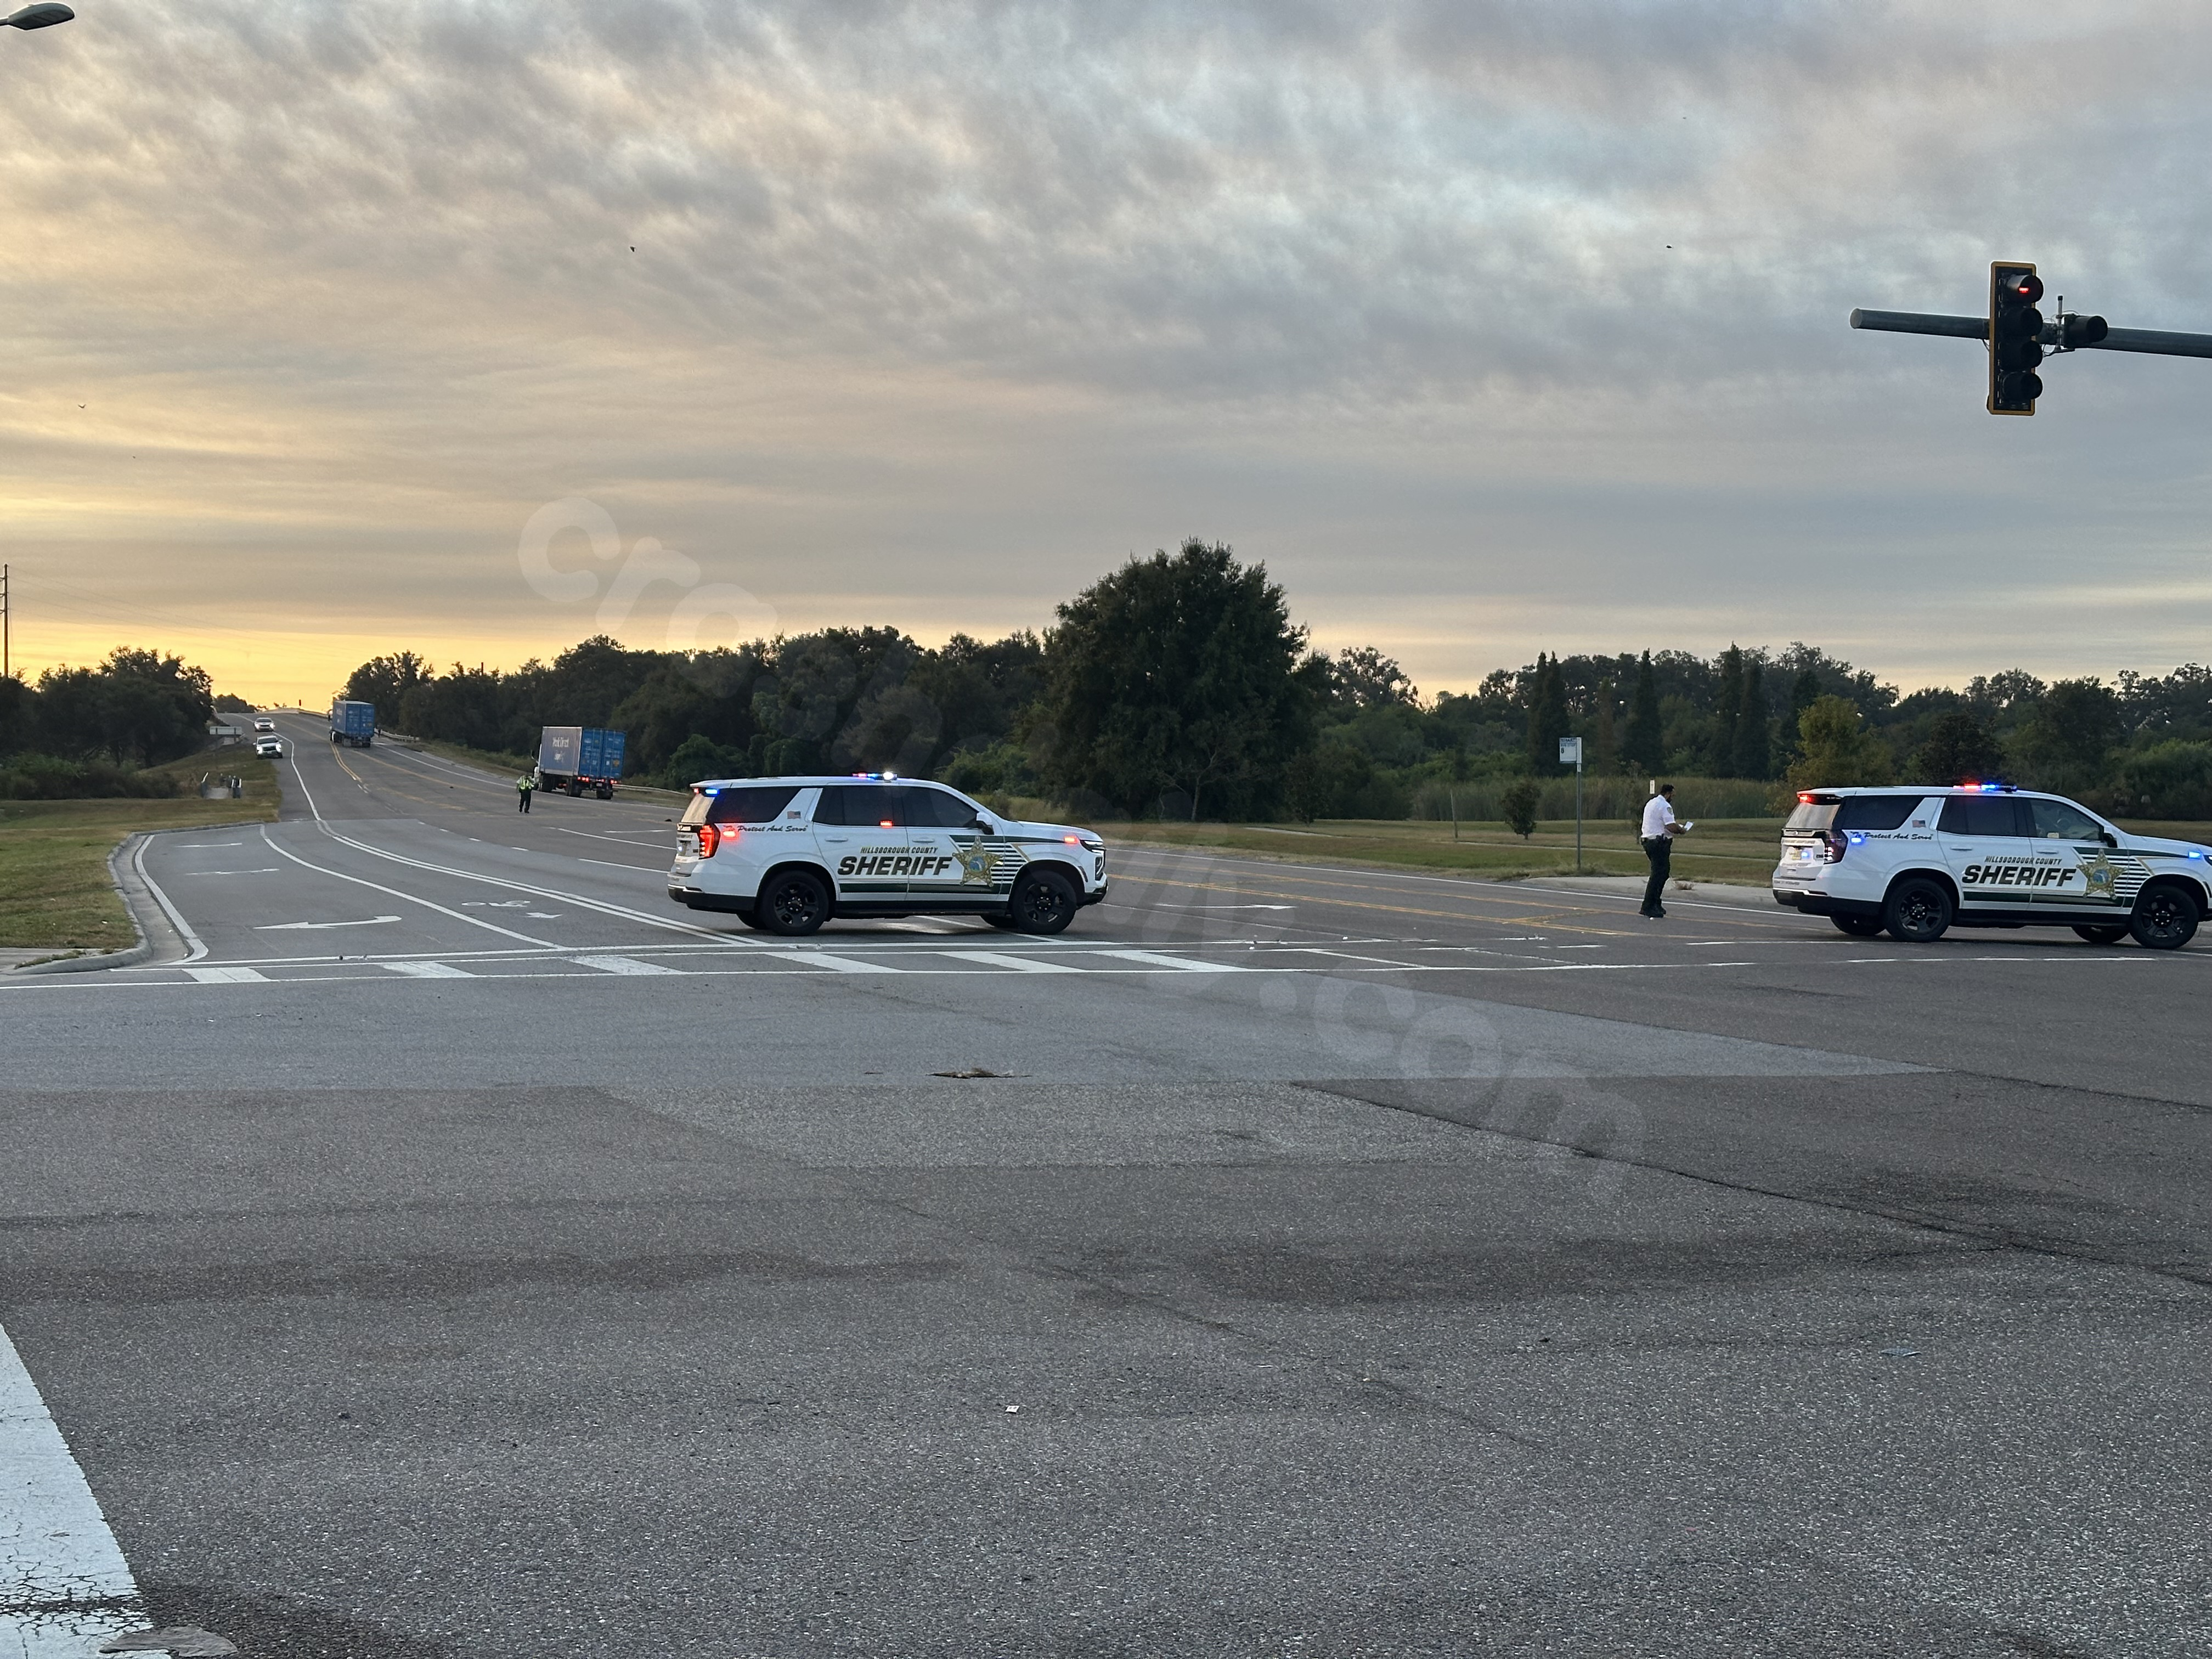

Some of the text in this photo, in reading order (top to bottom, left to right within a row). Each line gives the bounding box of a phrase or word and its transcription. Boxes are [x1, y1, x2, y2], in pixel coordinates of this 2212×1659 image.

[837, 856, 953, 876] SHERIFF
[1984, 855, 2063, 866] HILLSBOROUGH COUNTY
[1961, 865, 2076, 887] SHERIFF
